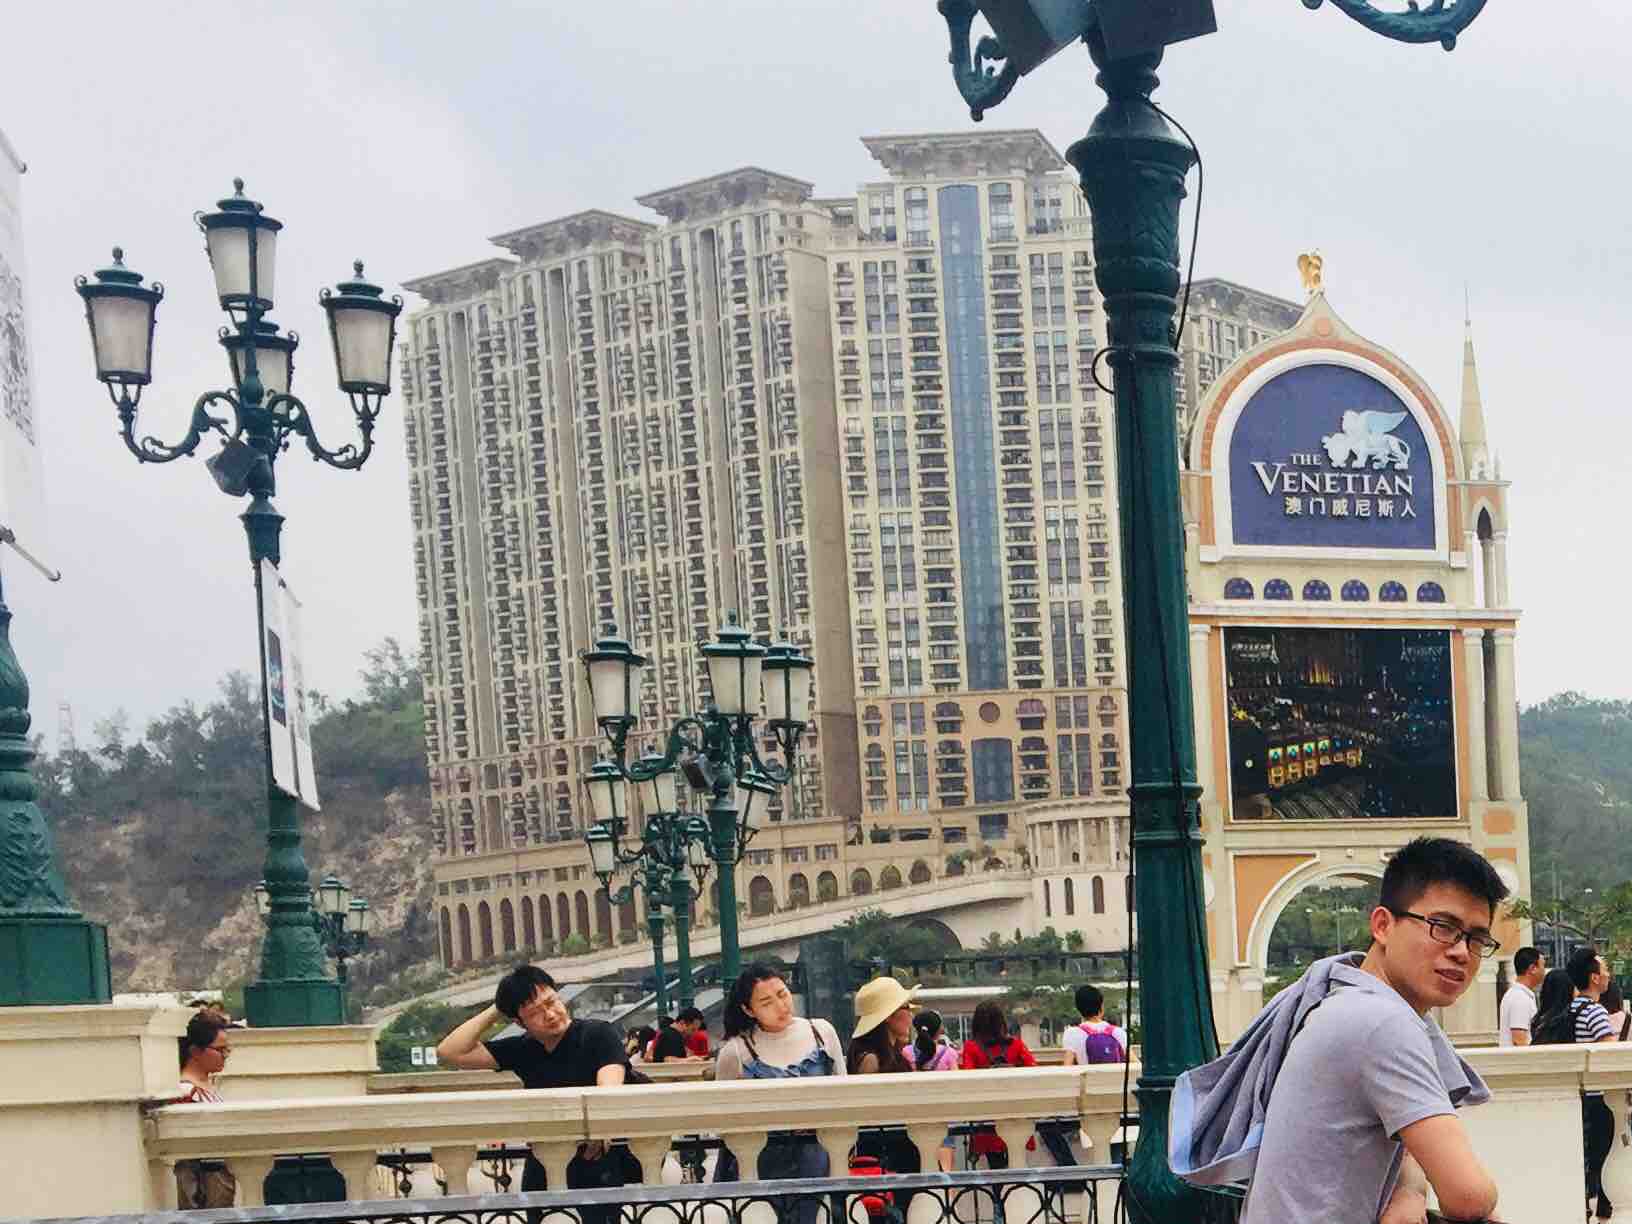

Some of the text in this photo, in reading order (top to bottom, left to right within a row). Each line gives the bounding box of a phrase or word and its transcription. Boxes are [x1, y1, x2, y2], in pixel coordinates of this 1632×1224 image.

[1290, 453, 1322, 465] THE
[1250, 461, 1415, 496] VENETIAN
[1284, 496, 1418, 518] 澳门威尼斯人
